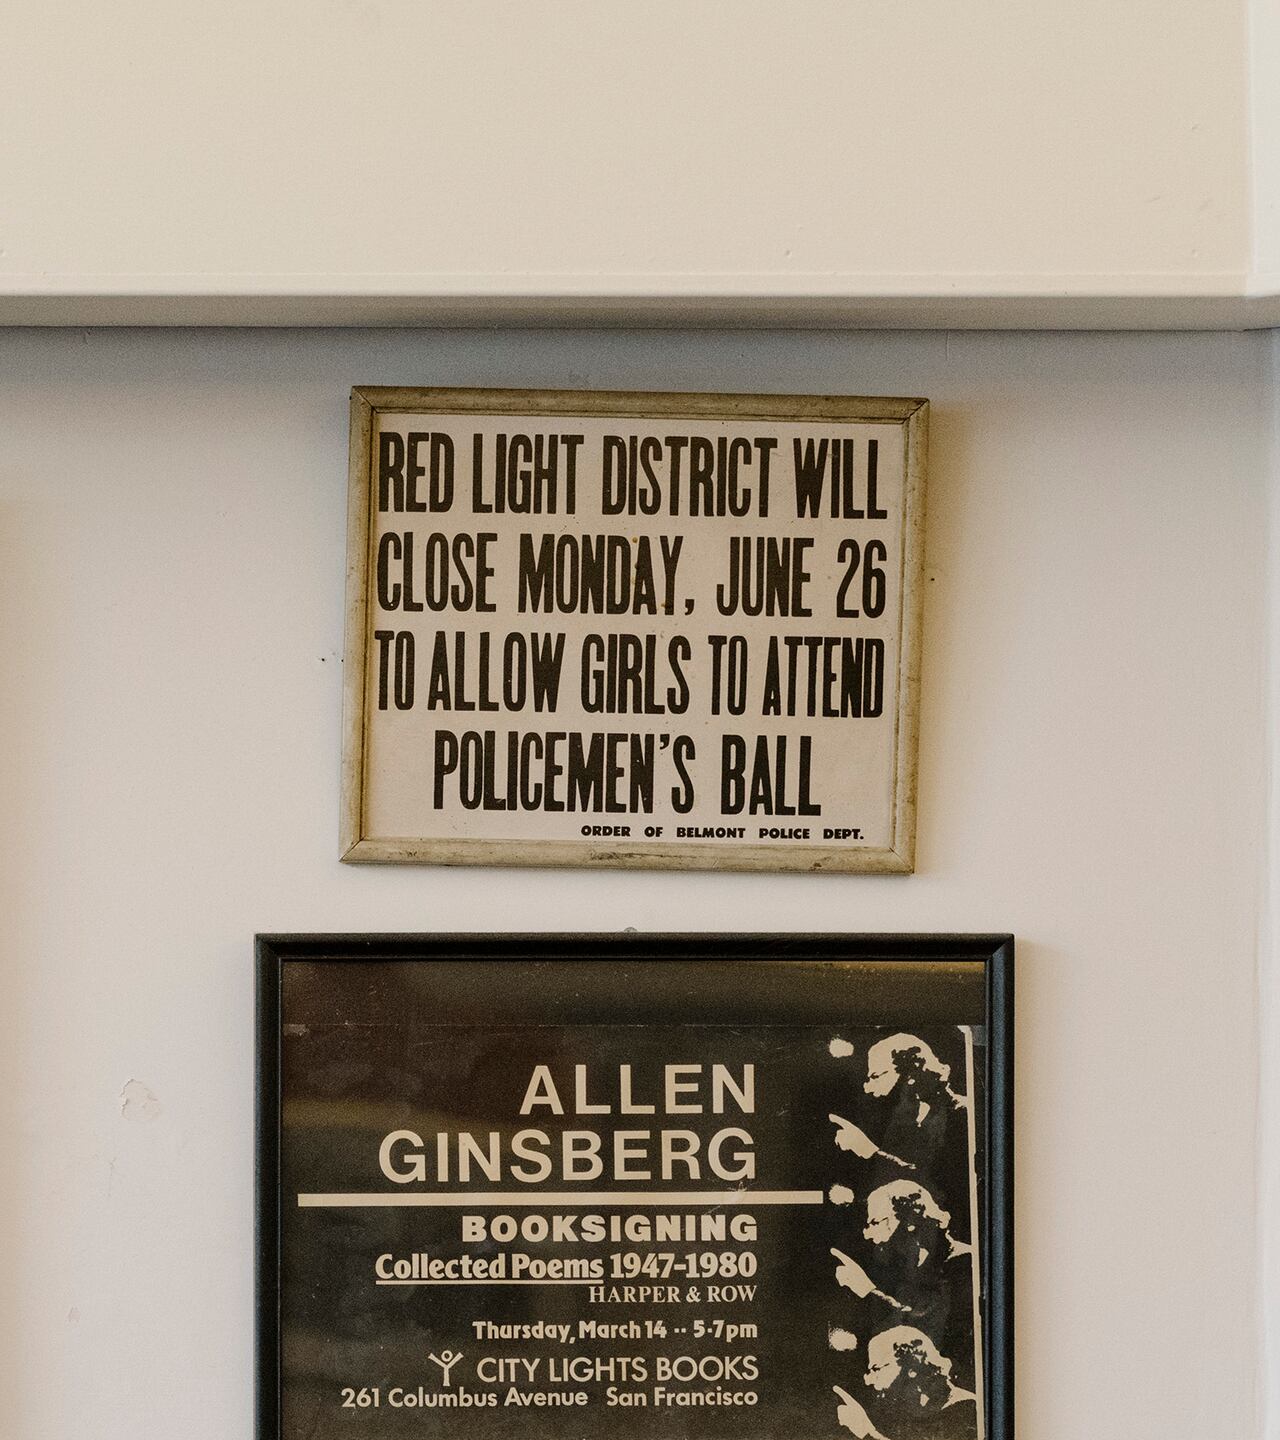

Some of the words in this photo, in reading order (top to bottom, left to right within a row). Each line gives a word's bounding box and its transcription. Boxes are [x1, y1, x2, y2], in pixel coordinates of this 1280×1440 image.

[378, 431, 456, 514] RED
[472, 433, 585, 515] LIGHT
[601, 435, 778, 518] DISTRICT
[793, 438, 888, 520] WILL
[376, 531, 498, 614] CLOSE
[518, 533, 695, 617] MONDAY,
[716, 536, 815, 617] JUNE
[836, 538, 887, 619] 26
[374, 630, 416, 712] TO
[427, 631, 566, 714] ALLOW
[580, 633, 691, 715] GIRLS
[707, 634, 748, 717] TO
[761, 635, 885, 718] ATTEND
[432, 729, 696, 815] POLICEMEN'S
[720, 734, 822, 816] BALL
[580, 825, 631, 838] ORDER
[644, 826, 663, 838] OF
[676, 826, 746, 840] BELMONT
[759, 827, 810, 840] POLICE
[823, 828, 865, 841] DEPT.
[519, 1063, 755, 1115] ALLEN
[378, 1128, 757, 1184] GINSBERG
[461, 1213, 759, 1244] BOOKSIGNING
[375, 1253, 508, 1280] Collected
[511, 1253, 604, 1279] Poems
[610, 1252, 758, 1279] 1947-1980
[588, 1285, 682, 1304] HARPER
[685, 1285, 702, 1304] &
[706, 1285, 758, 1303] ROW
[472, 1320, 576, 1344] Thursday,
[579, 1320, 640, 1340] March
[644, 1321, 667, 1340] 14
[477, 1356, 542, 1384] CITY
[549, 1356, 647, 1383] LIGHTS
[655, 1356, 759, 1383] BOOKS
[340, 1387, 381, 1408] 261
[388, 1387, 498, 1408] Columbus
[503, 1387, 589, 1407] Avenue
[606, 1387, 650, 1407] San
[654, 1387, 759, 1407] Francisco
